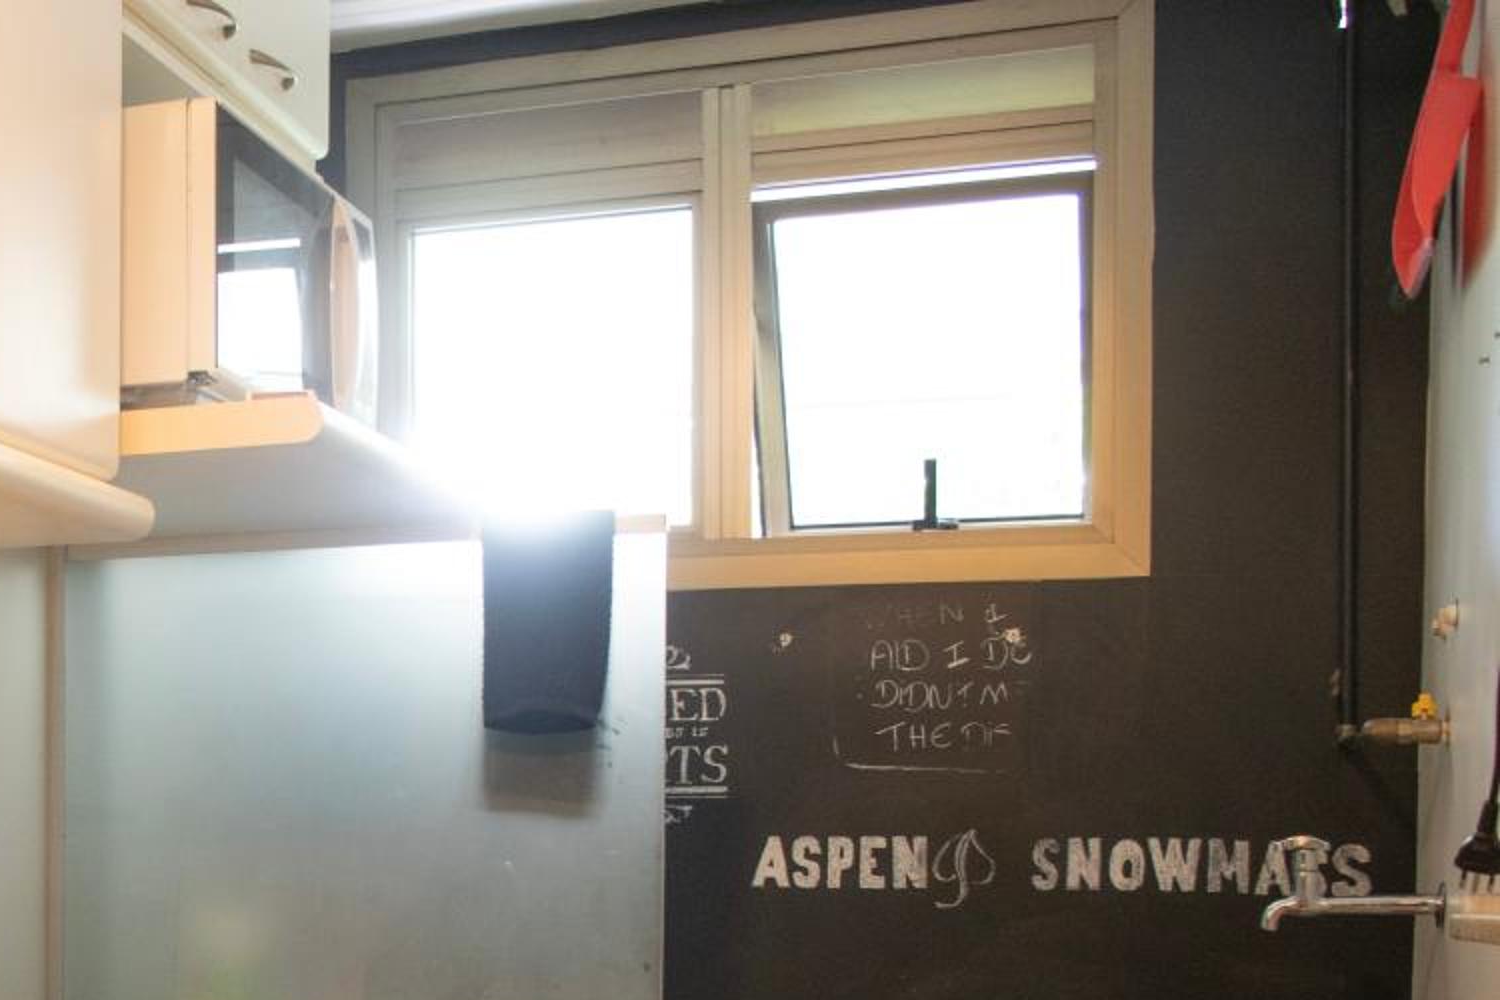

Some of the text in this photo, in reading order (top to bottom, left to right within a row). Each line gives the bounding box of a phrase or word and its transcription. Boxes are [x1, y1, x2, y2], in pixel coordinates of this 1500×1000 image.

[875, 721, 951, 752] THE
[664, 745, 729, 784] TS
[751, 835, 929, 890] ASPEN
